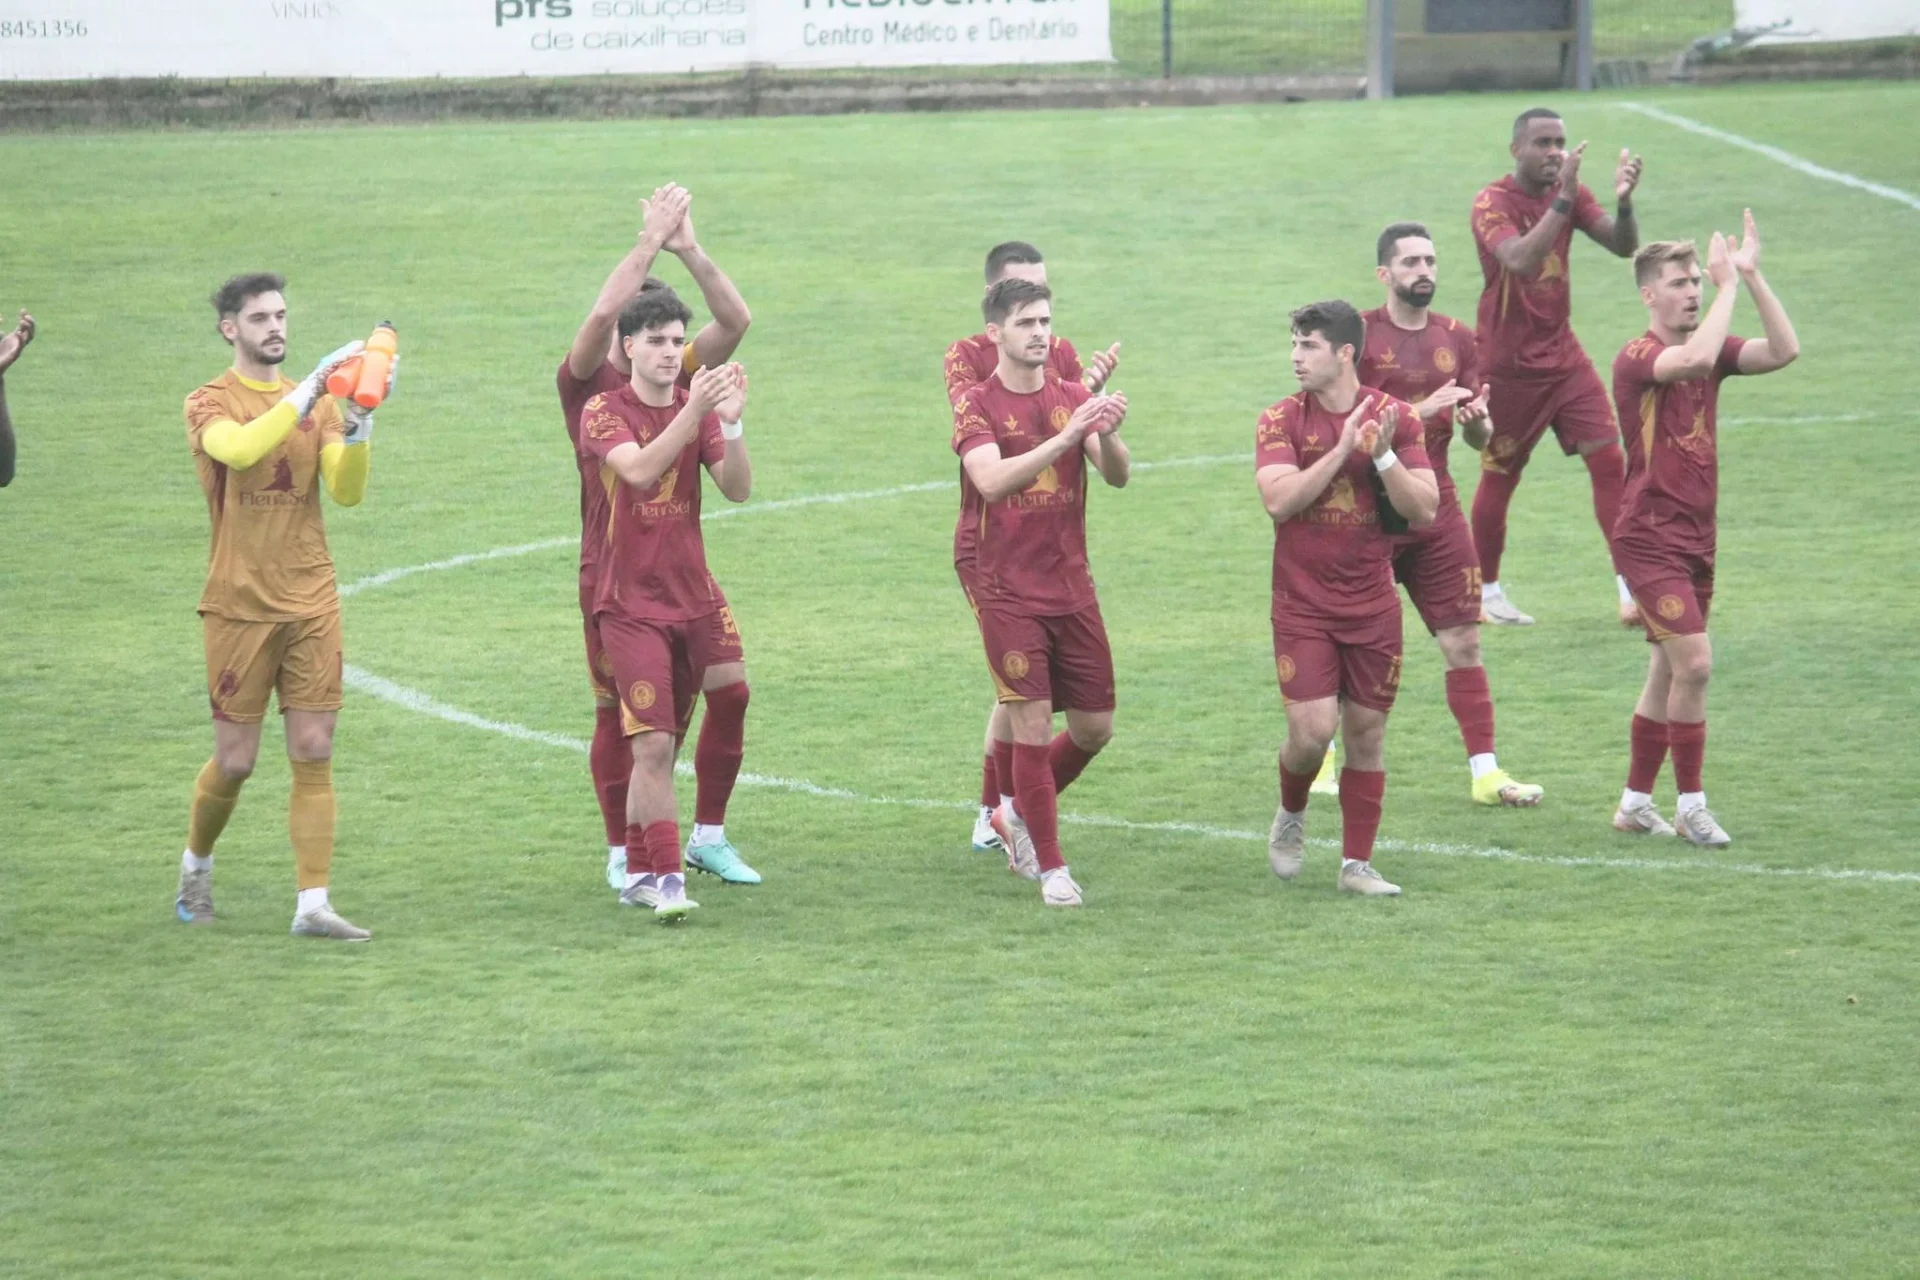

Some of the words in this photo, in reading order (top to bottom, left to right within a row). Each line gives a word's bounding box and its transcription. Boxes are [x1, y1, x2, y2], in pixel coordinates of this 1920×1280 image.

[0, 19, 88, 38] 8451356
[530, 28, 574, 51] de
[583, 25, 746, 49] caixilharia
[803, 22, 873, 46] Centro
[883, 20, 958, 43] Médico
[967, 25, 980, 42] e
[989, 17, 1078, 41] Dentário
